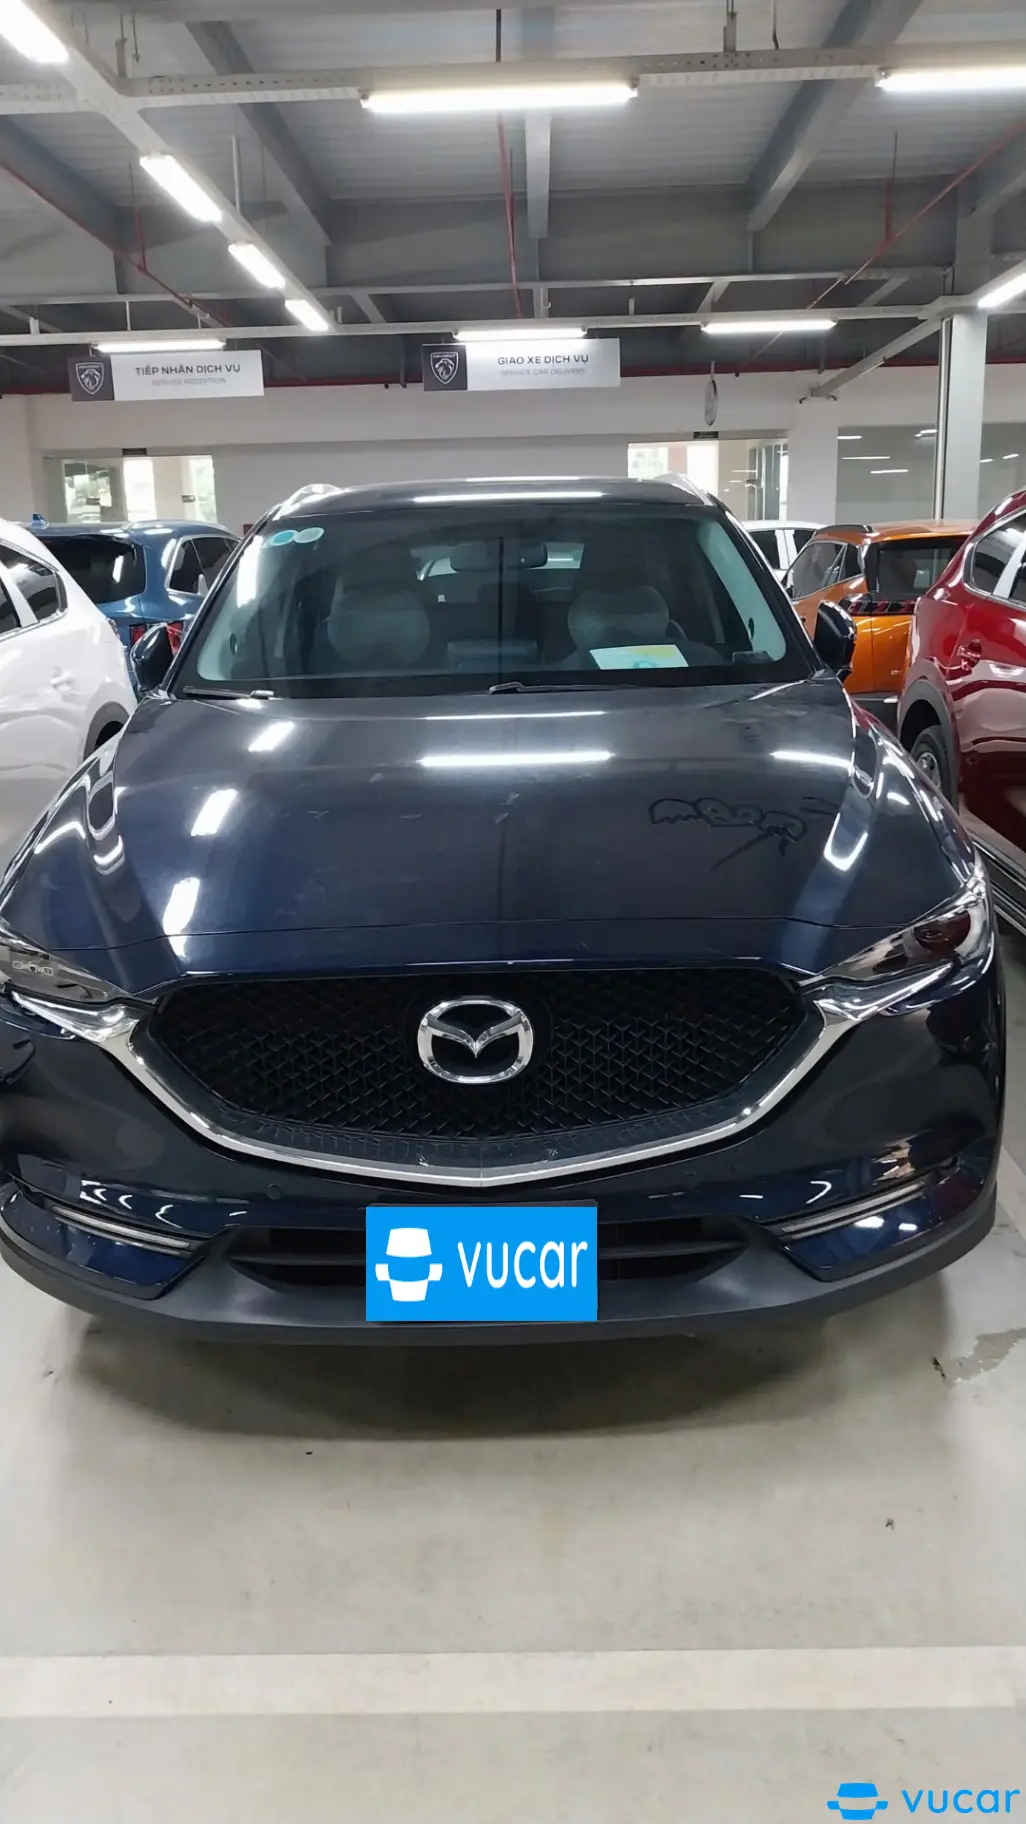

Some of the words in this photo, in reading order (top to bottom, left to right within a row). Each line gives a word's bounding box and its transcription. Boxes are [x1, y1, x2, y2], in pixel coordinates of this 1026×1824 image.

[497, 356, 524, 365] GIAO
[527, 355, 541, 364] XE
[544, 355, 570, 364] DỊCH
[573, 354, 589, 364] VỤ
[135, 364, 159, 375] TIẾP
[196, 364, 222, 374] DỊCH
[225, 364, 241, 373] VỤ
